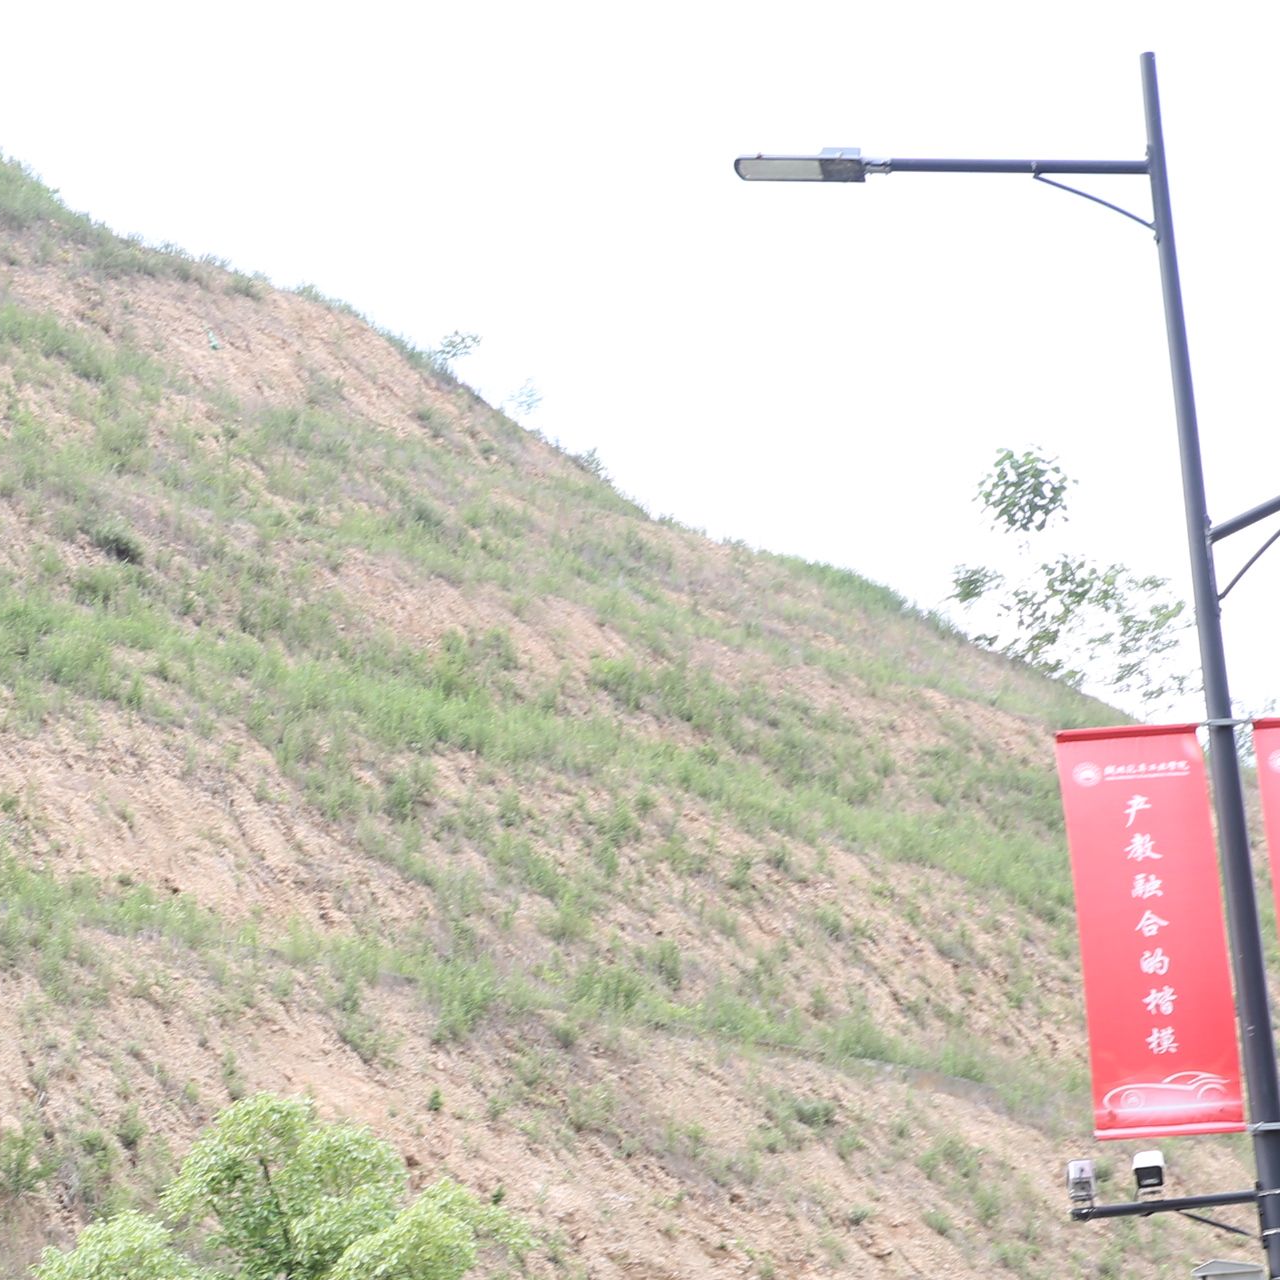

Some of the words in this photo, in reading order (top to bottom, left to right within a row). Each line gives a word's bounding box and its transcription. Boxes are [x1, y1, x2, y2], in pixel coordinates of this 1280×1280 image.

[1123, 794, 1180, 1054] 产教融合的楷模
